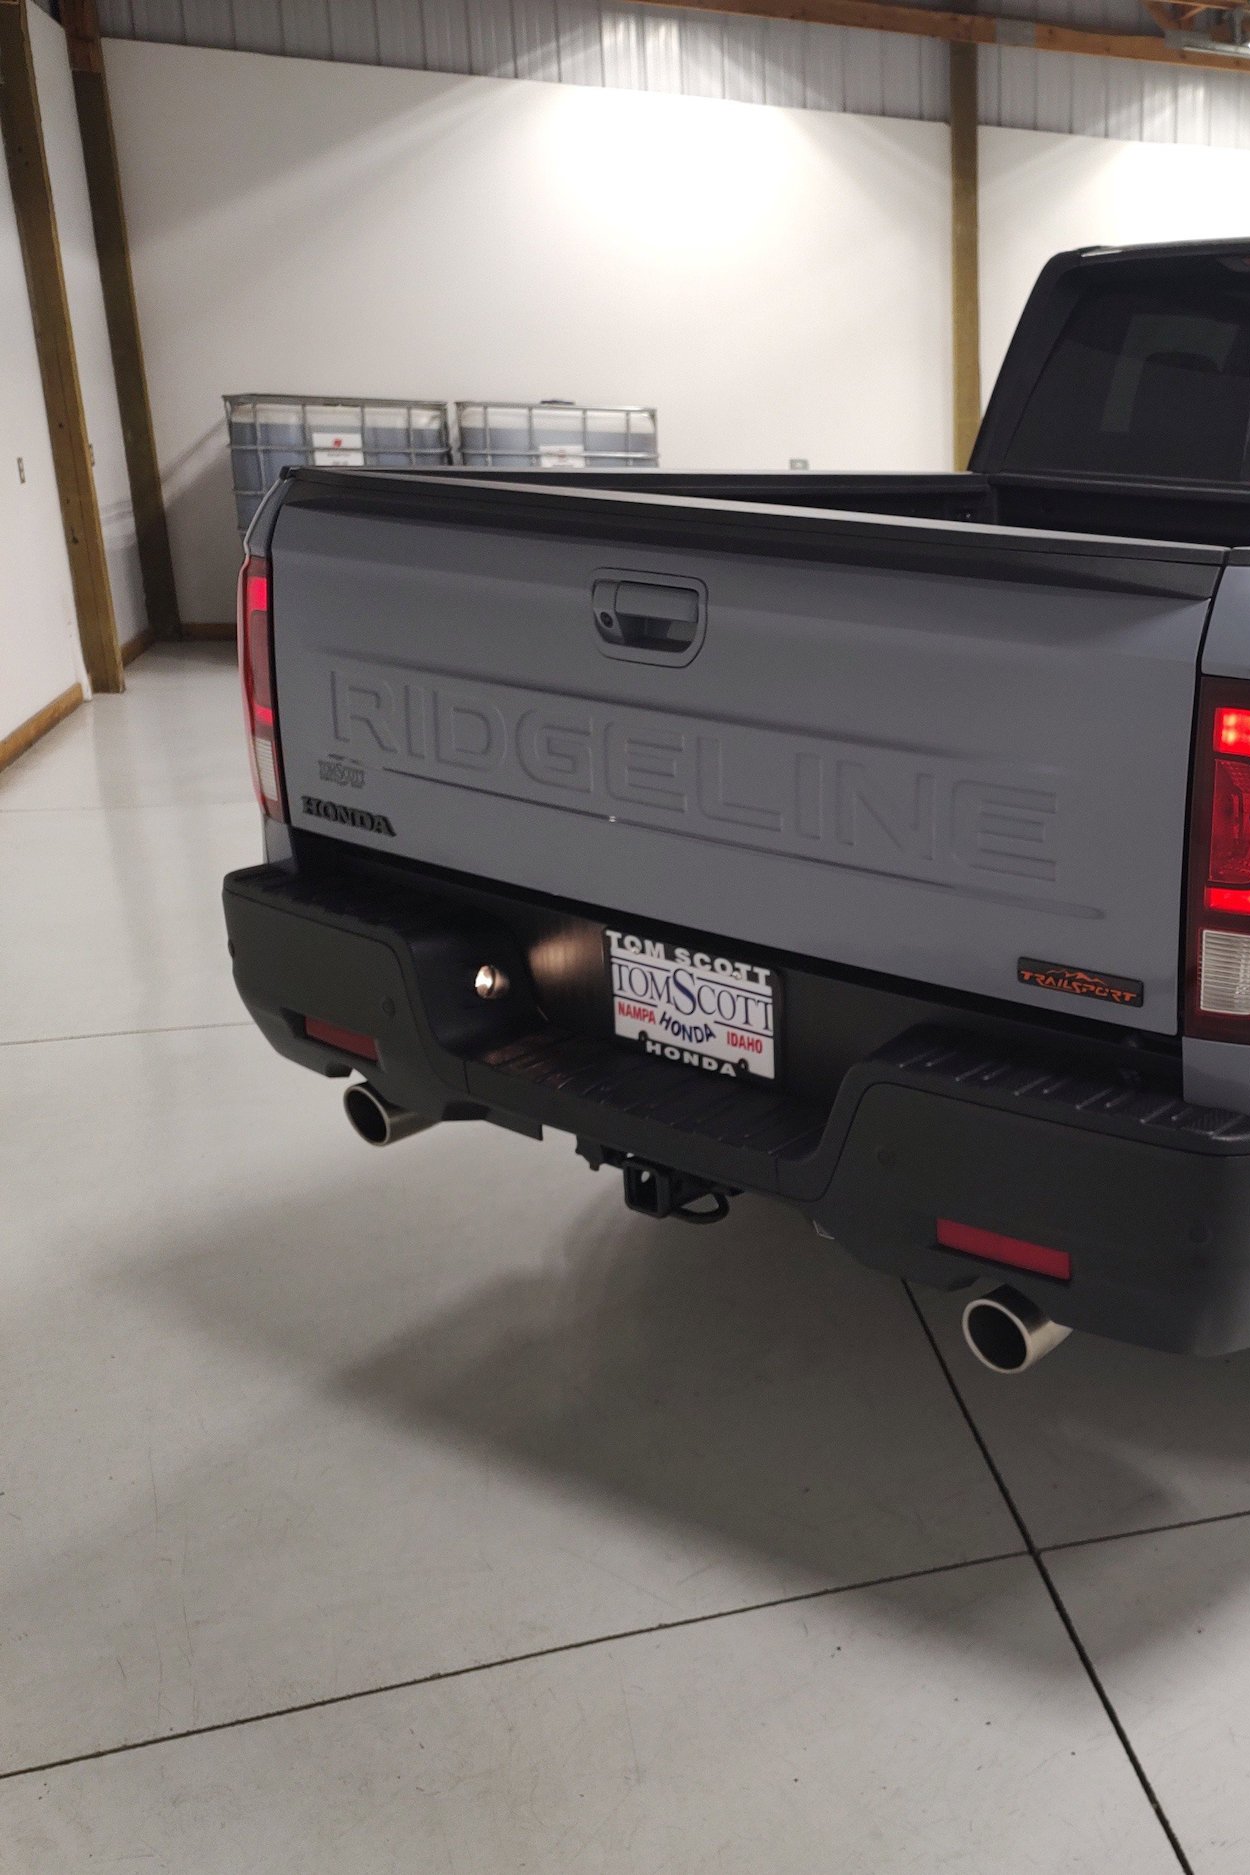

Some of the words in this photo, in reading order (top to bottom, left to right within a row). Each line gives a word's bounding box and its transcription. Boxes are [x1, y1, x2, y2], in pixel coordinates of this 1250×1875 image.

[329, 669, 1058, 882] RIDGELINE
[301, 795, 397, 837] HONDA
[605, 929, 665, 960] TOM
[673, 947, 771, 986] SCOTT
[1020, 970, 1137, 1003] TRAILSPORT
[617, 1001, 656, 1025] NAMPA
[659, 1011, 716, 1044] HONDA
[645, 1040, 737, 1077] HONDA
[727, 1031, 763, 1054] IDAHO
